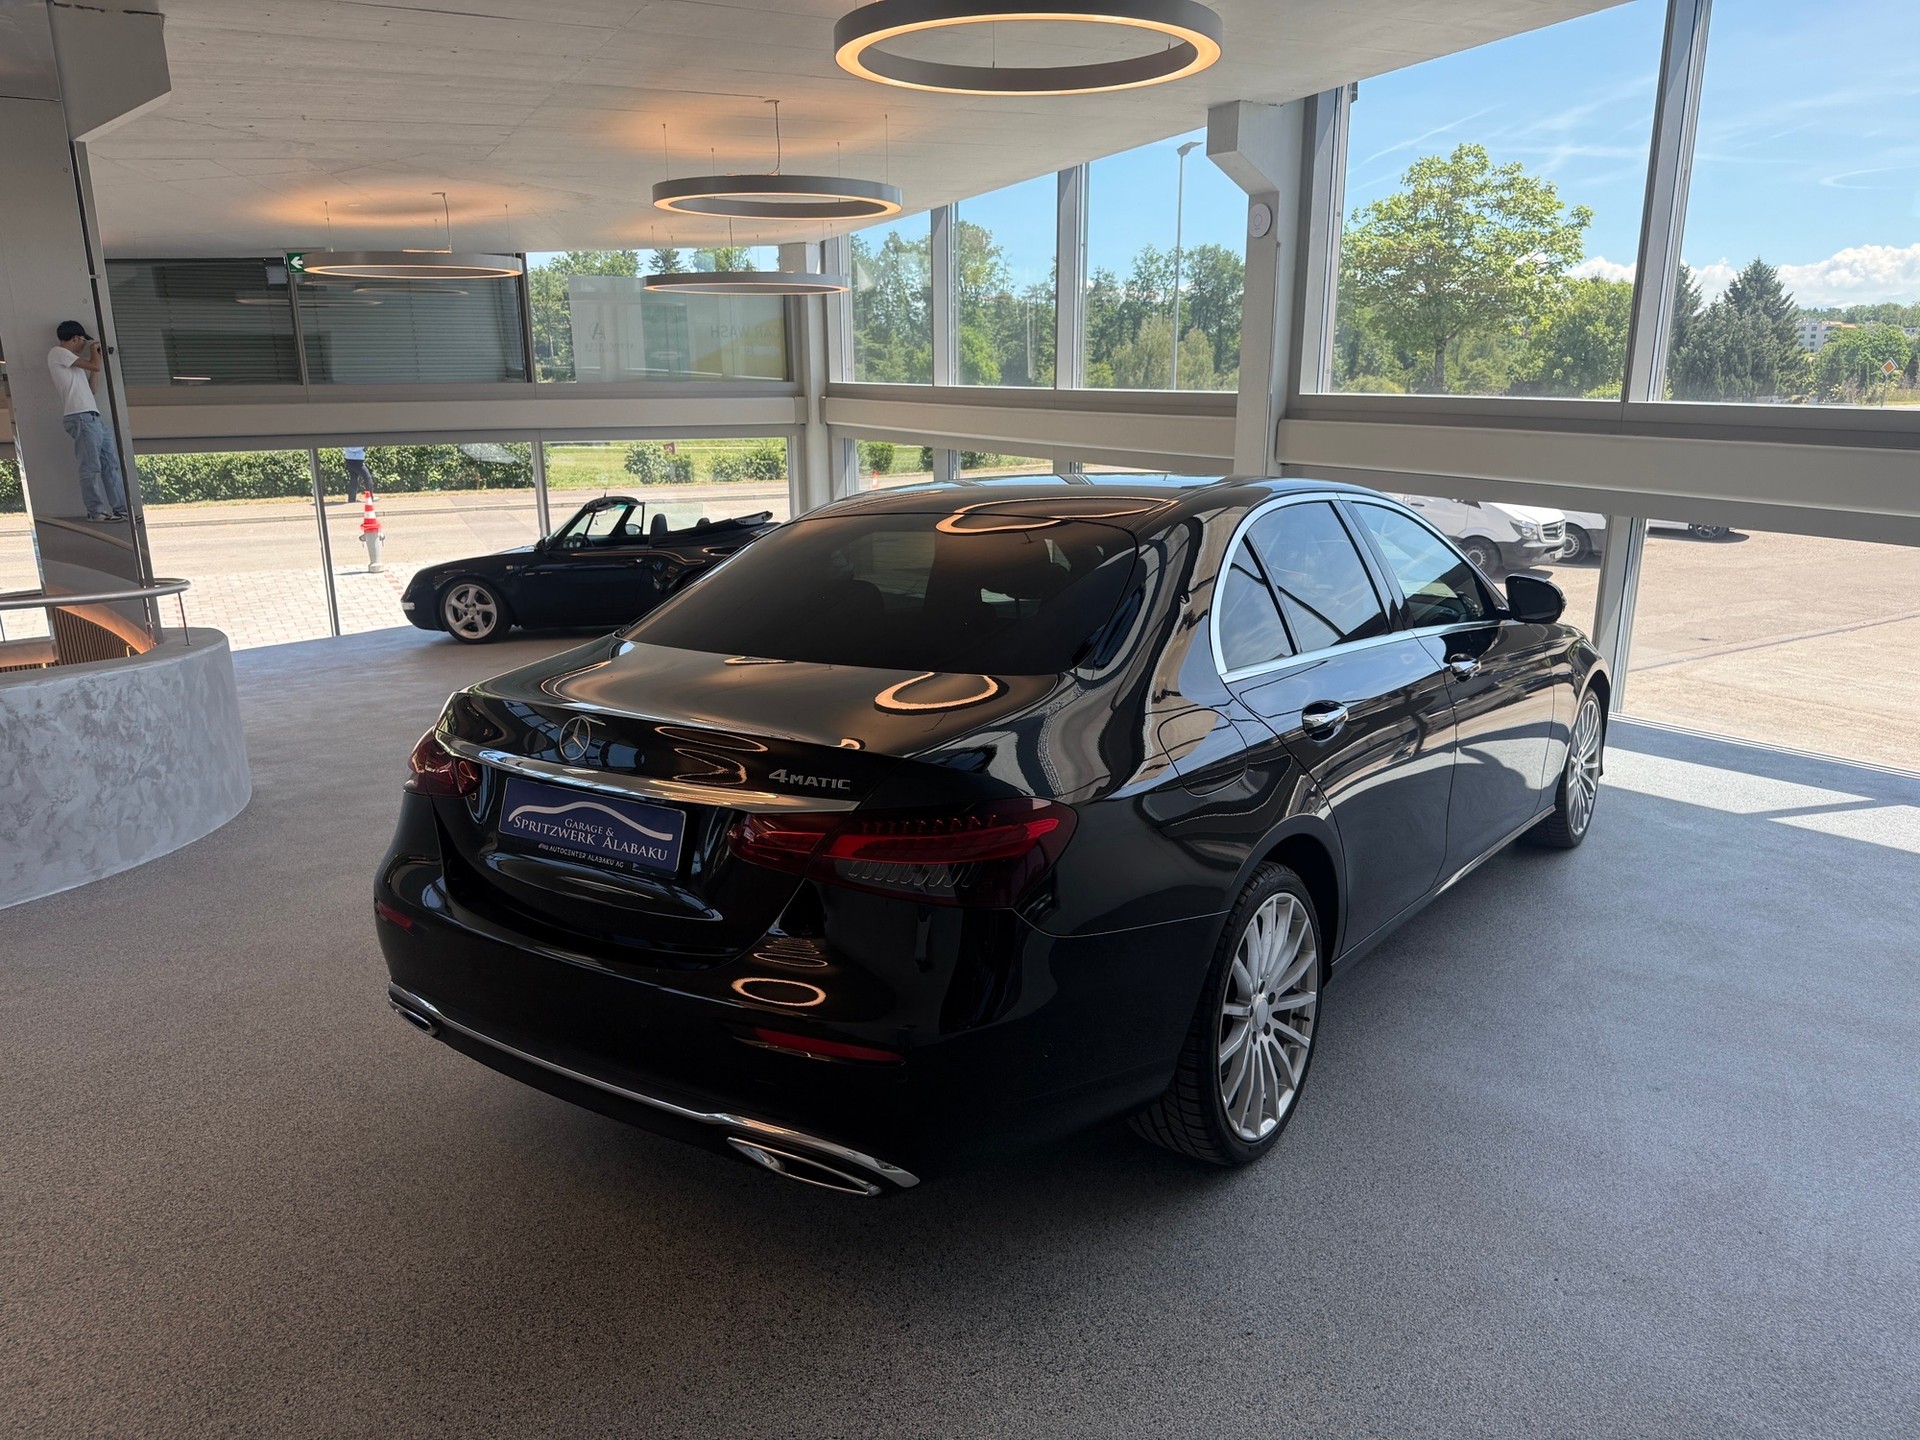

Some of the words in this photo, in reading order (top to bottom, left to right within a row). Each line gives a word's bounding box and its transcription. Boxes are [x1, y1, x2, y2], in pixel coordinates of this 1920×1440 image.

[768, 768, 851, 791] 4MATIC
[513, 816, 596, 846] SPRITZWERK
[602, 836, 668, 861] ALABAKU
[564, 818, 603, 835] GARAGE
[605, 826, 615, 838] &
[549, 845, 587, 860] AUTOCENTER
[587, 854, 615, 866] ALABAKU
[614, 860, 624, 868] AG
